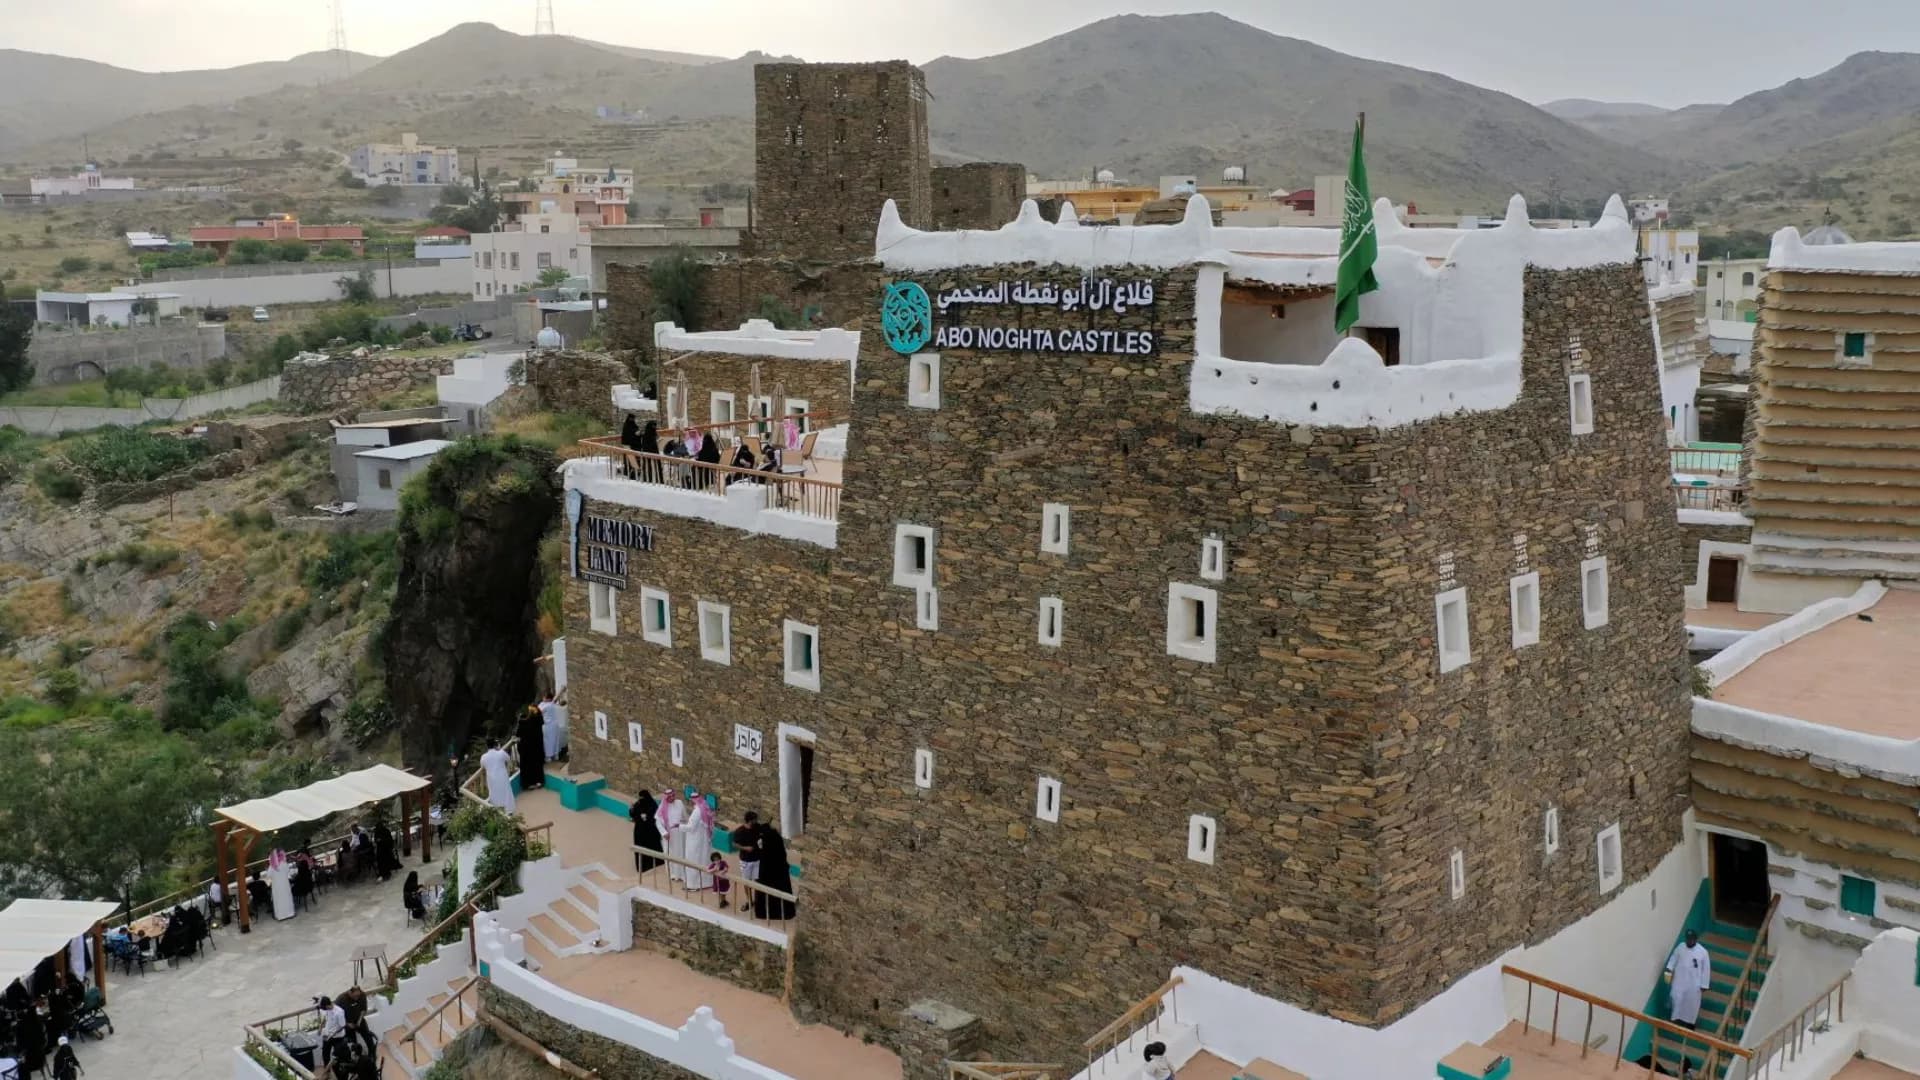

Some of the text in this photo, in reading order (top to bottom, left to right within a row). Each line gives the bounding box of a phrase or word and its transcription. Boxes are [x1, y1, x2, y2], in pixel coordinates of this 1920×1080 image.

[937, 276, 1153, 315] قلاع آل أبو نقطة المتحمي
[935, 326, 1153, 354] ABO NOGHTA CASTLES
[587, 514, 654, 552] MEMORY
[588, 544, 628, 577] LANE
